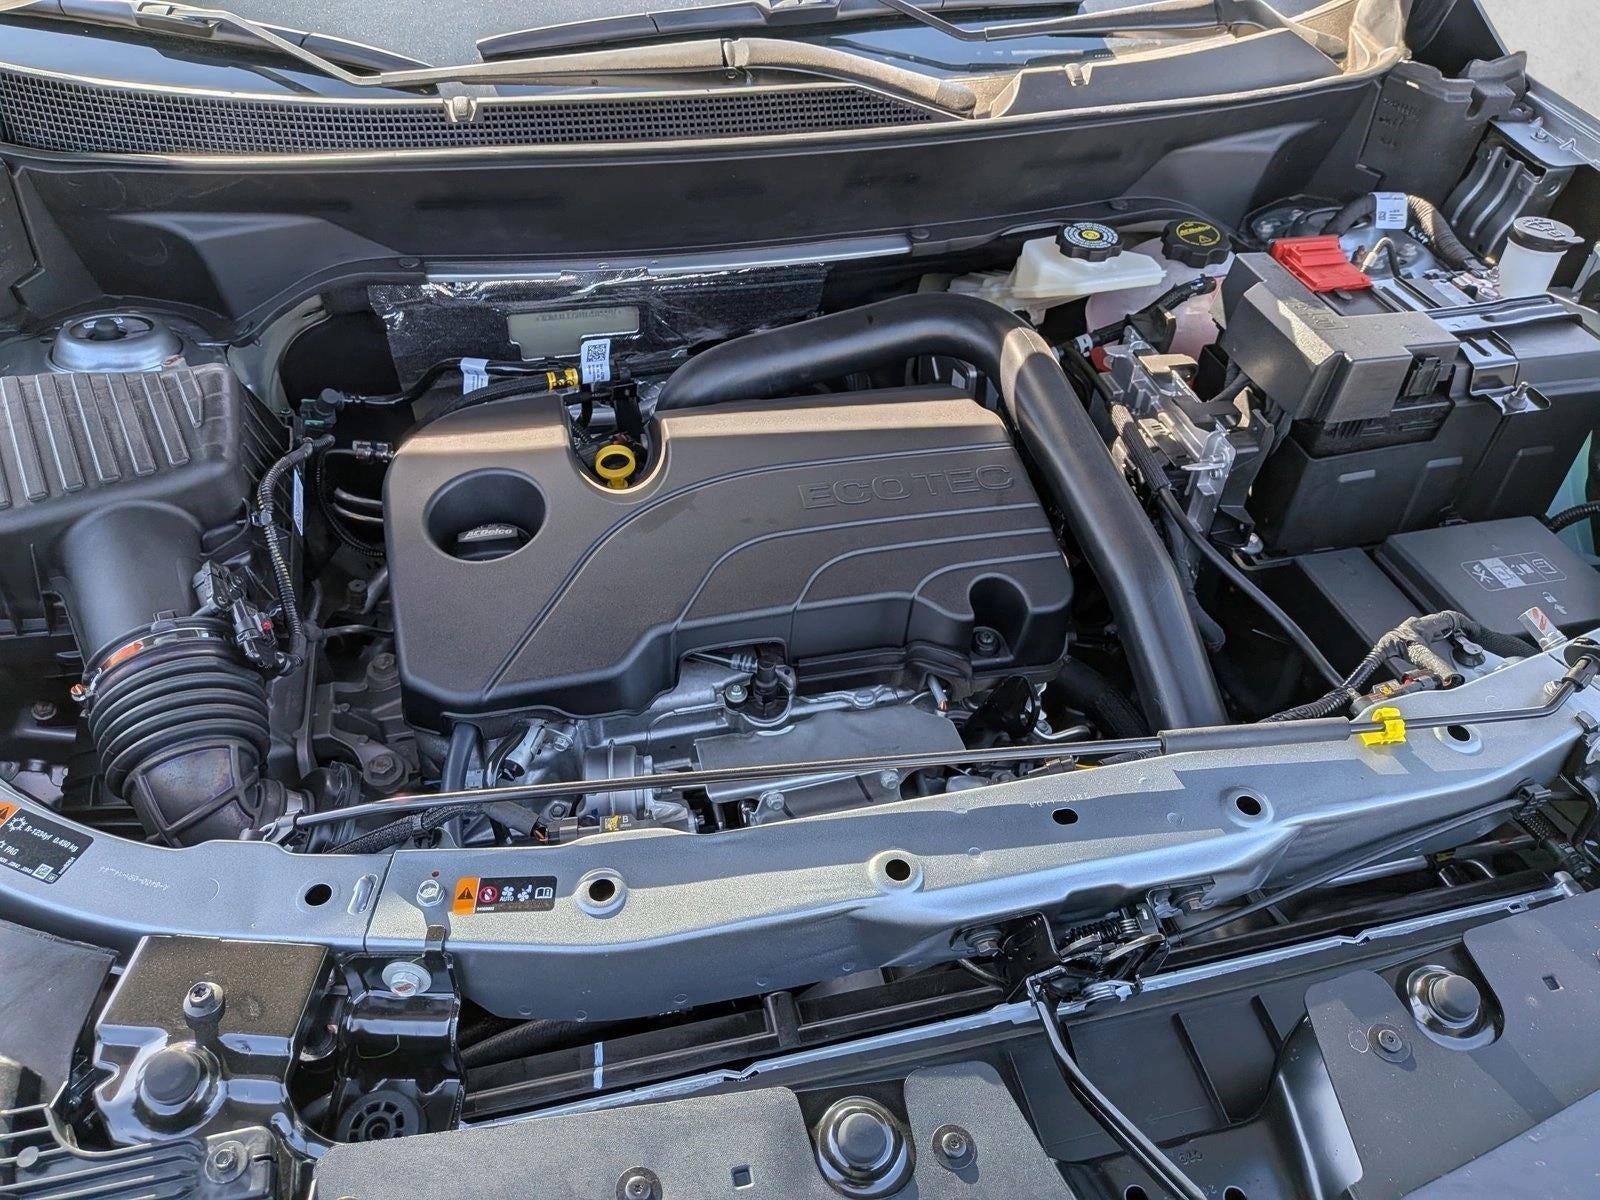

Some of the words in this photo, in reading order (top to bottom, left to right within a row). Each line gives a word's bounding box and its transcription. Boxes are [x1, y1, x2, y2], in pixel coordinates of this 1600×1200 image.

[798, 464, 1015, 509] ECOTEC
[24, 825, 53, 841] R-1234yf
[4, 845, 19, 856] PAG
